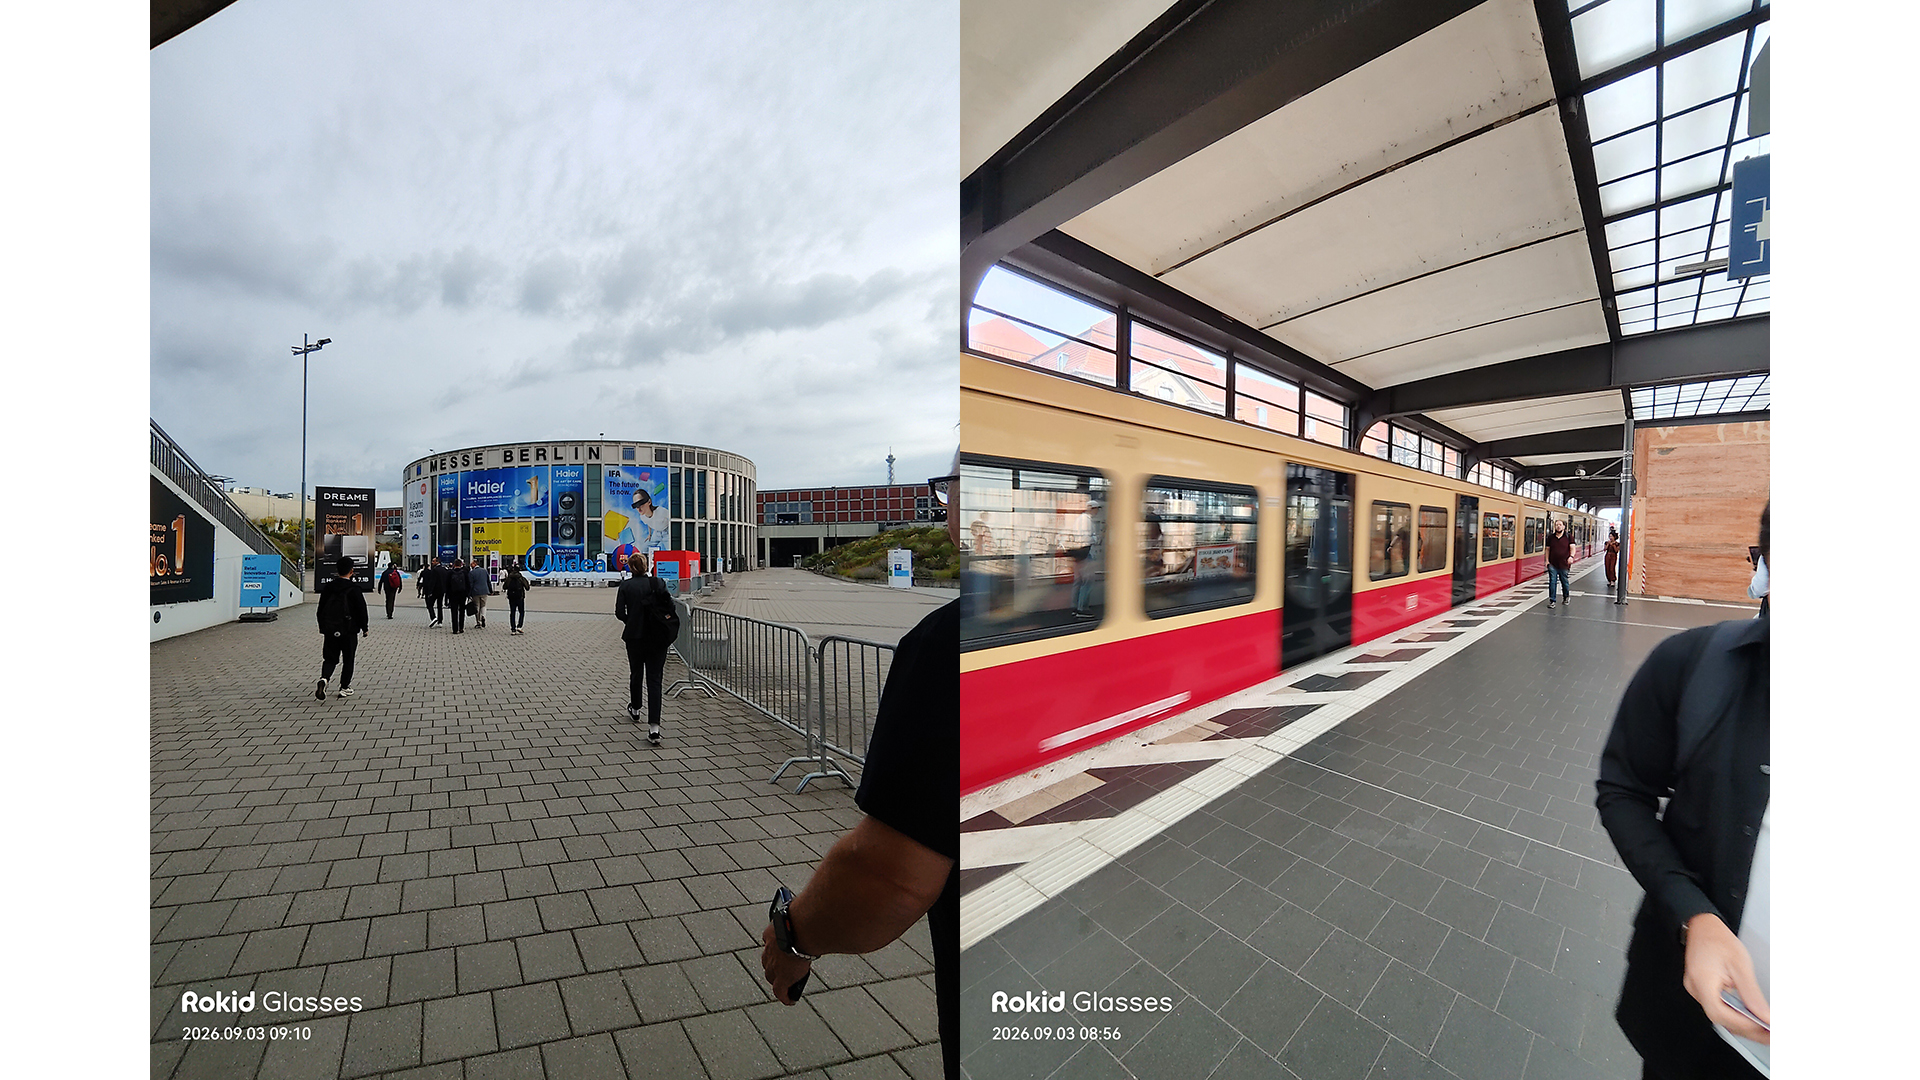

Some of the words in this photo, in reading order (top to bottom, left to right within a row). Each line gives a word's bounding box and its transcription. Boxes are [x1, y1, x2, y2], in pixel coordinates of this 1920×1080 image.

[430, 453, 483, 473] MESSE
[503, 447, 600, 464] BERLIN
[555, 469, 580, 478] Haier
[608, 470, 621, 478] IFA
[468, 479, 506, 495] Haier
[323, 493, 368, 501] DREAME
[171, 514, 186, 576] 1
